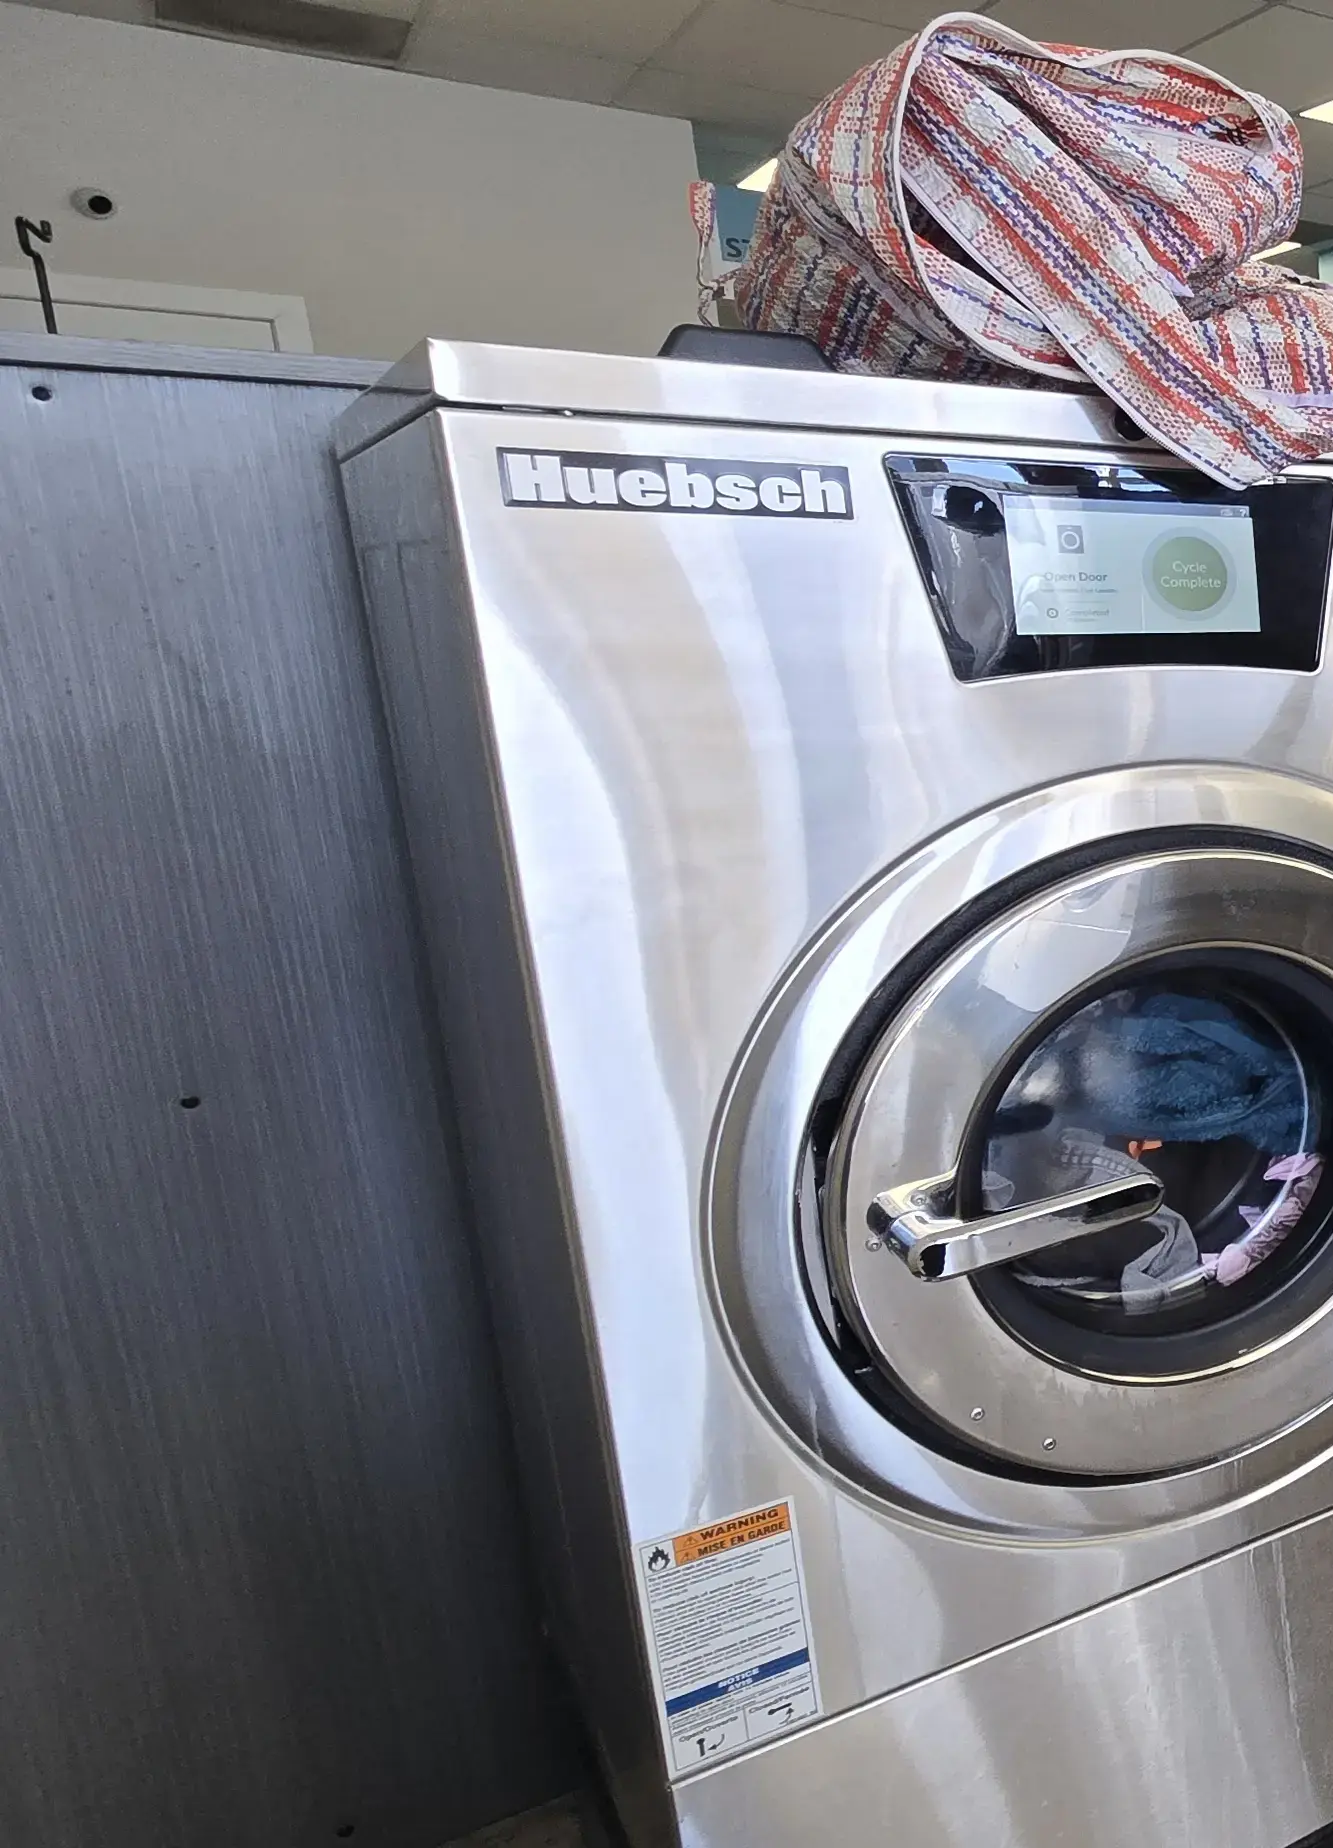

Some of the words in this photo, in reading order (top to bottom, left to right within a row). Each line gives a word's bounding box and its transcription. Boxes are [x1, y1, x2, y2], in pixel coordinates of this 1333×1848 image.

[501, 451, 847, 515] Huebsch
[1172, 560, 1207, 575] Cycle
[1044, 572, 1076, 583] Open
[1078, 571, 1108, 581] Door
[1160, 576, 1222, 590] Complete
[700, 1508, 779, 1541] WARNING
[697, 1541, 726, 1557] MISE
[730, 1534, 745, 1546] EN
[748, 1520, 786, 1540] GARDE
[717, 1668, 760, 1689] NOTICE
[727, 1678, 754, 1692] AVIS
